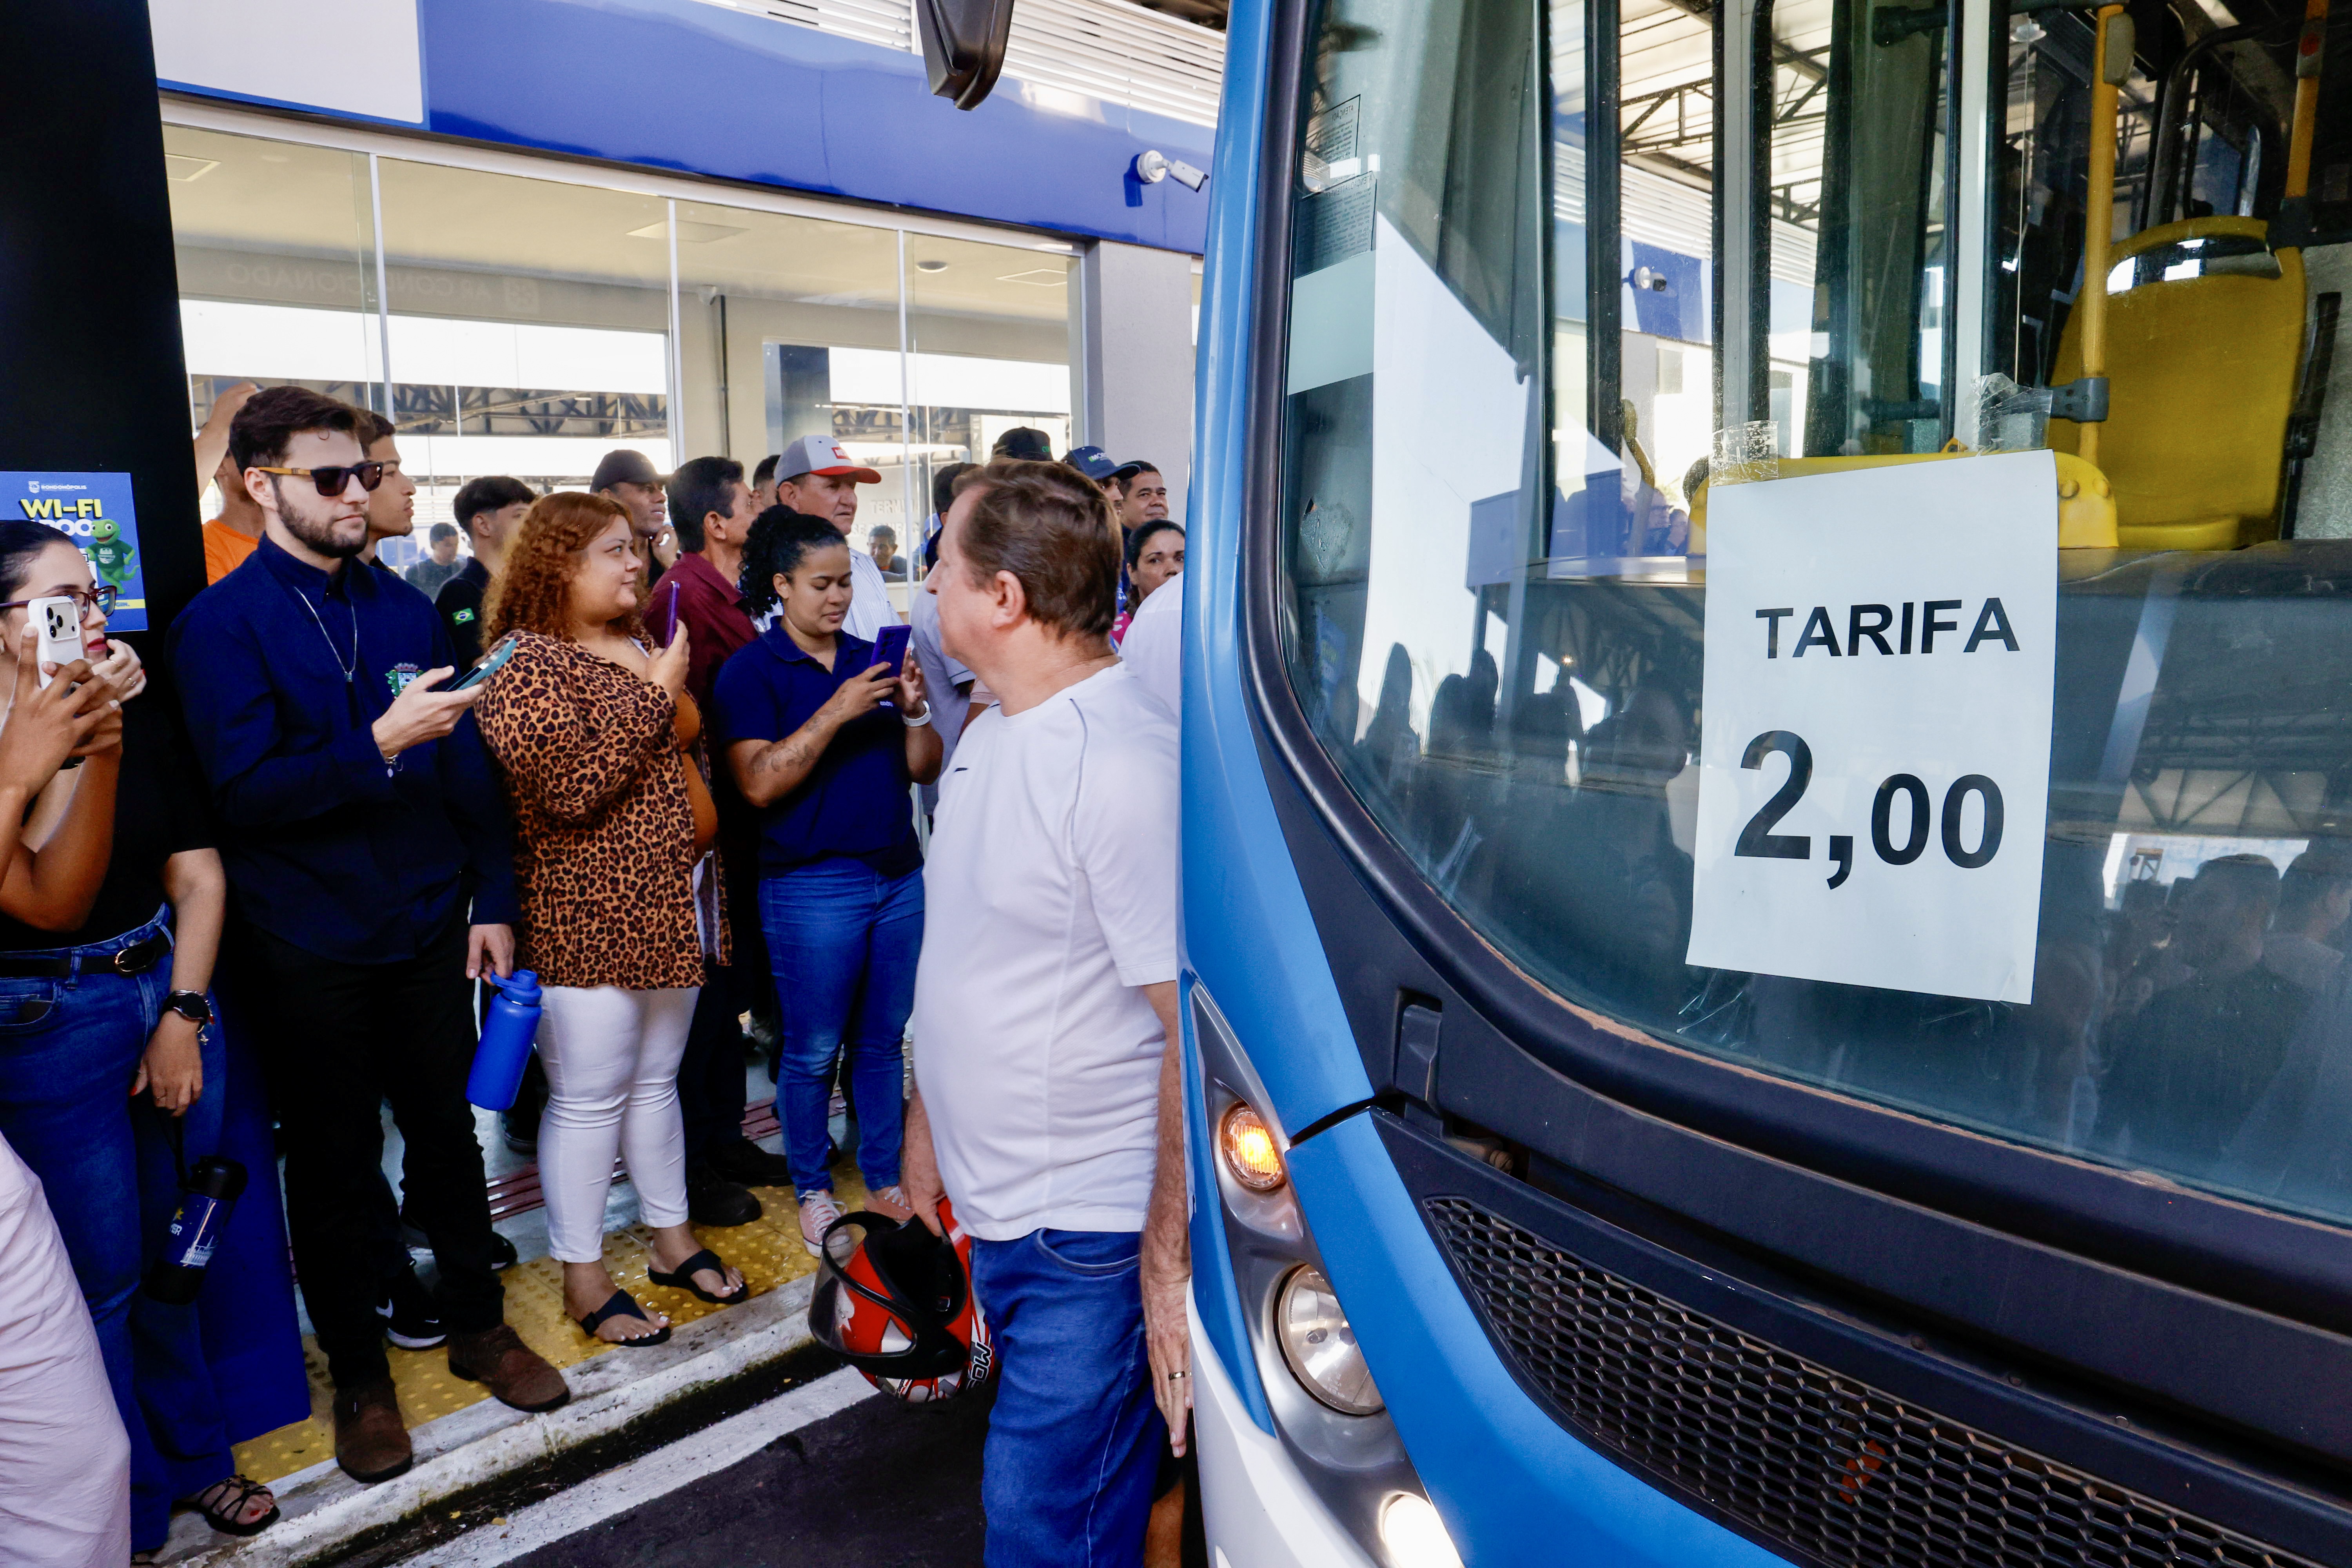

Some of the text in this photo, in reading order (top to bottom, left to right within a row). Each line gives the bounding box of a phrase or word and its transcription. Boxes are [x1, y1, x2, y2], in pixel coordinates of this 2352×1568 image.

[20, 499, 102, 519] WI-FI
[1756, 598, 2020, 659] TARIFA
[1734, 731, 2004, 889] 2,00
